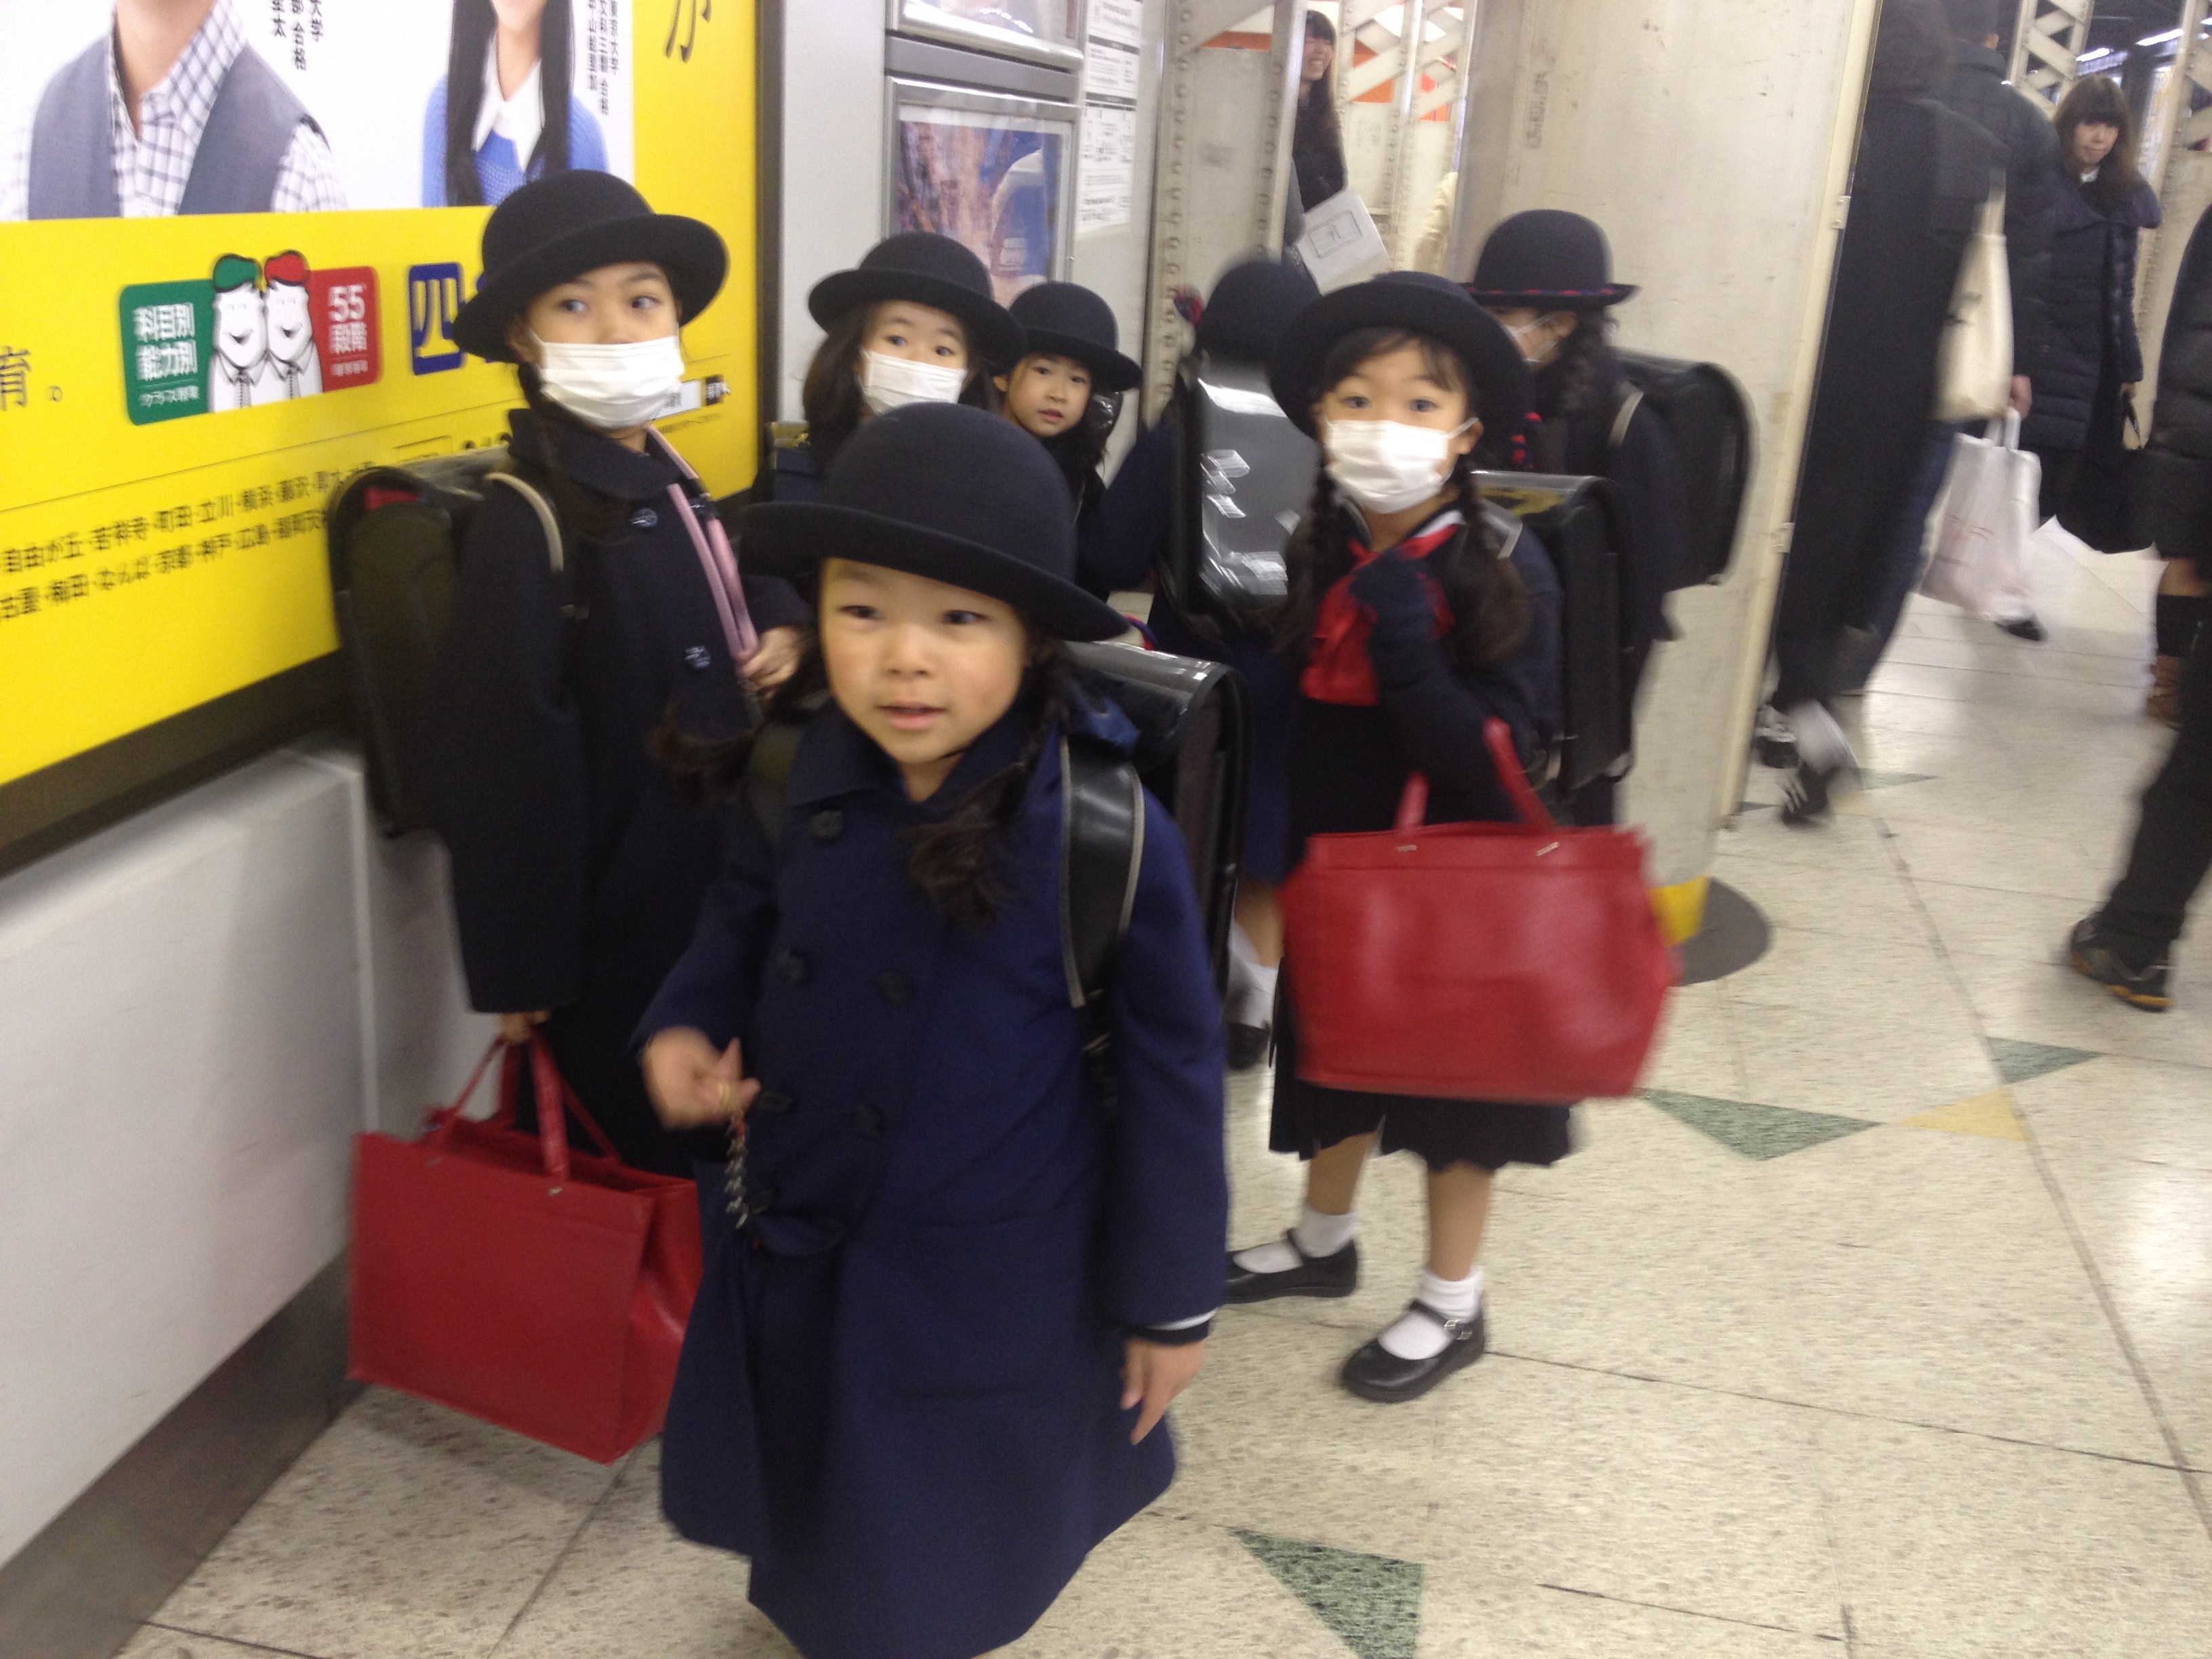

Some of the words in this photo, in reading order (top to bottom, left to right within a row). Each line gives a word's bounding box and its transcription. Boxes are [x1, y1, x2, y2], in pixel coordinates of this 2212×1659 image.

[292, 22, 306, 70] 合格
[133, 302, 195, 342] 科目別
[328, 285, 366, 323] 55
[136, 340, 198, 382] 能力別
